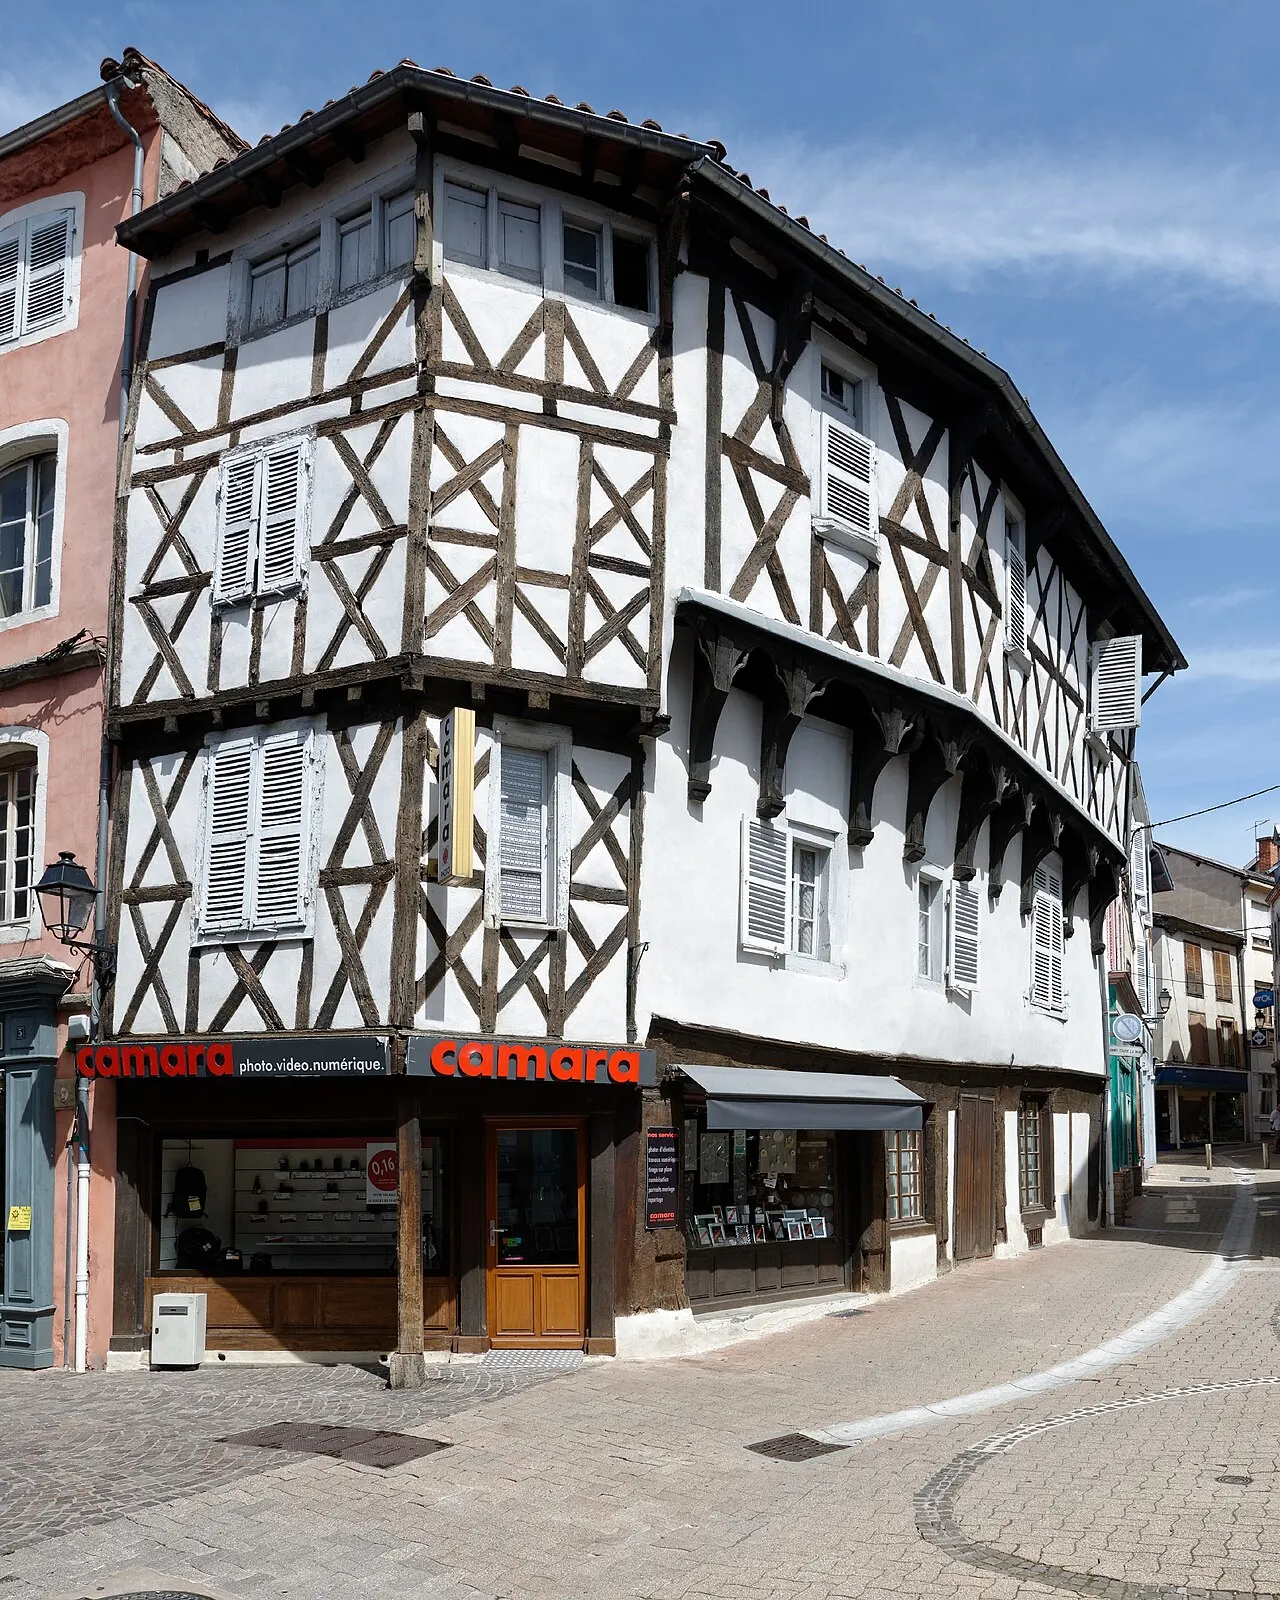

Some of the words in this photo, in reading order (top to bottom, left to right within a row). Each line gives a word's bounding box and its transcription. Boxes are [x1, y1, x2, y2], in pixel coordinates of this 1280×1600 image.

[441, 718, 451, 843] camara
[77, 1042, 233, 1077] camara
[430, 1040, 640, 1083] camara
